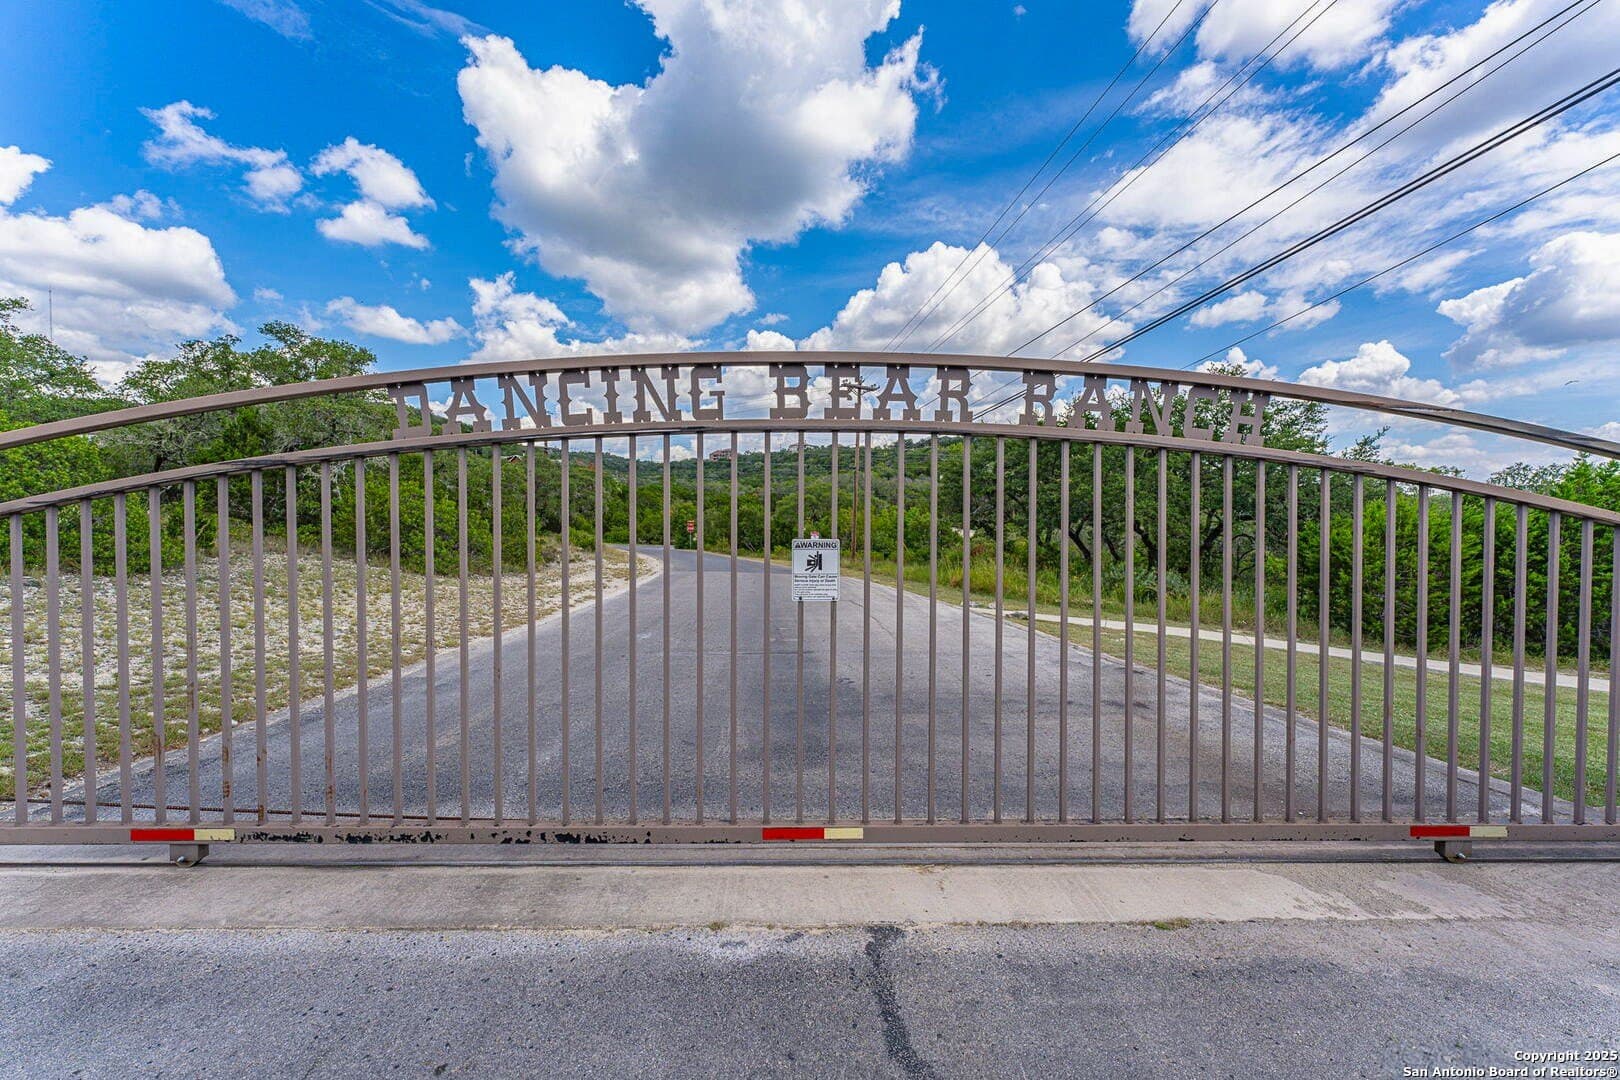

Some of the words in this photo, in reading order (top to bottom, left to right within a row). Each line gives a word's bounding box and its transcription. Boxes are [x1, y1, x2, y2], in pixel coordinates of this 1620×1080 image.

[392, 364, 725, 439] DANCING
[769, 362, 973, 421] BEAR
[1019, 369, 1270, 446] RANCH
